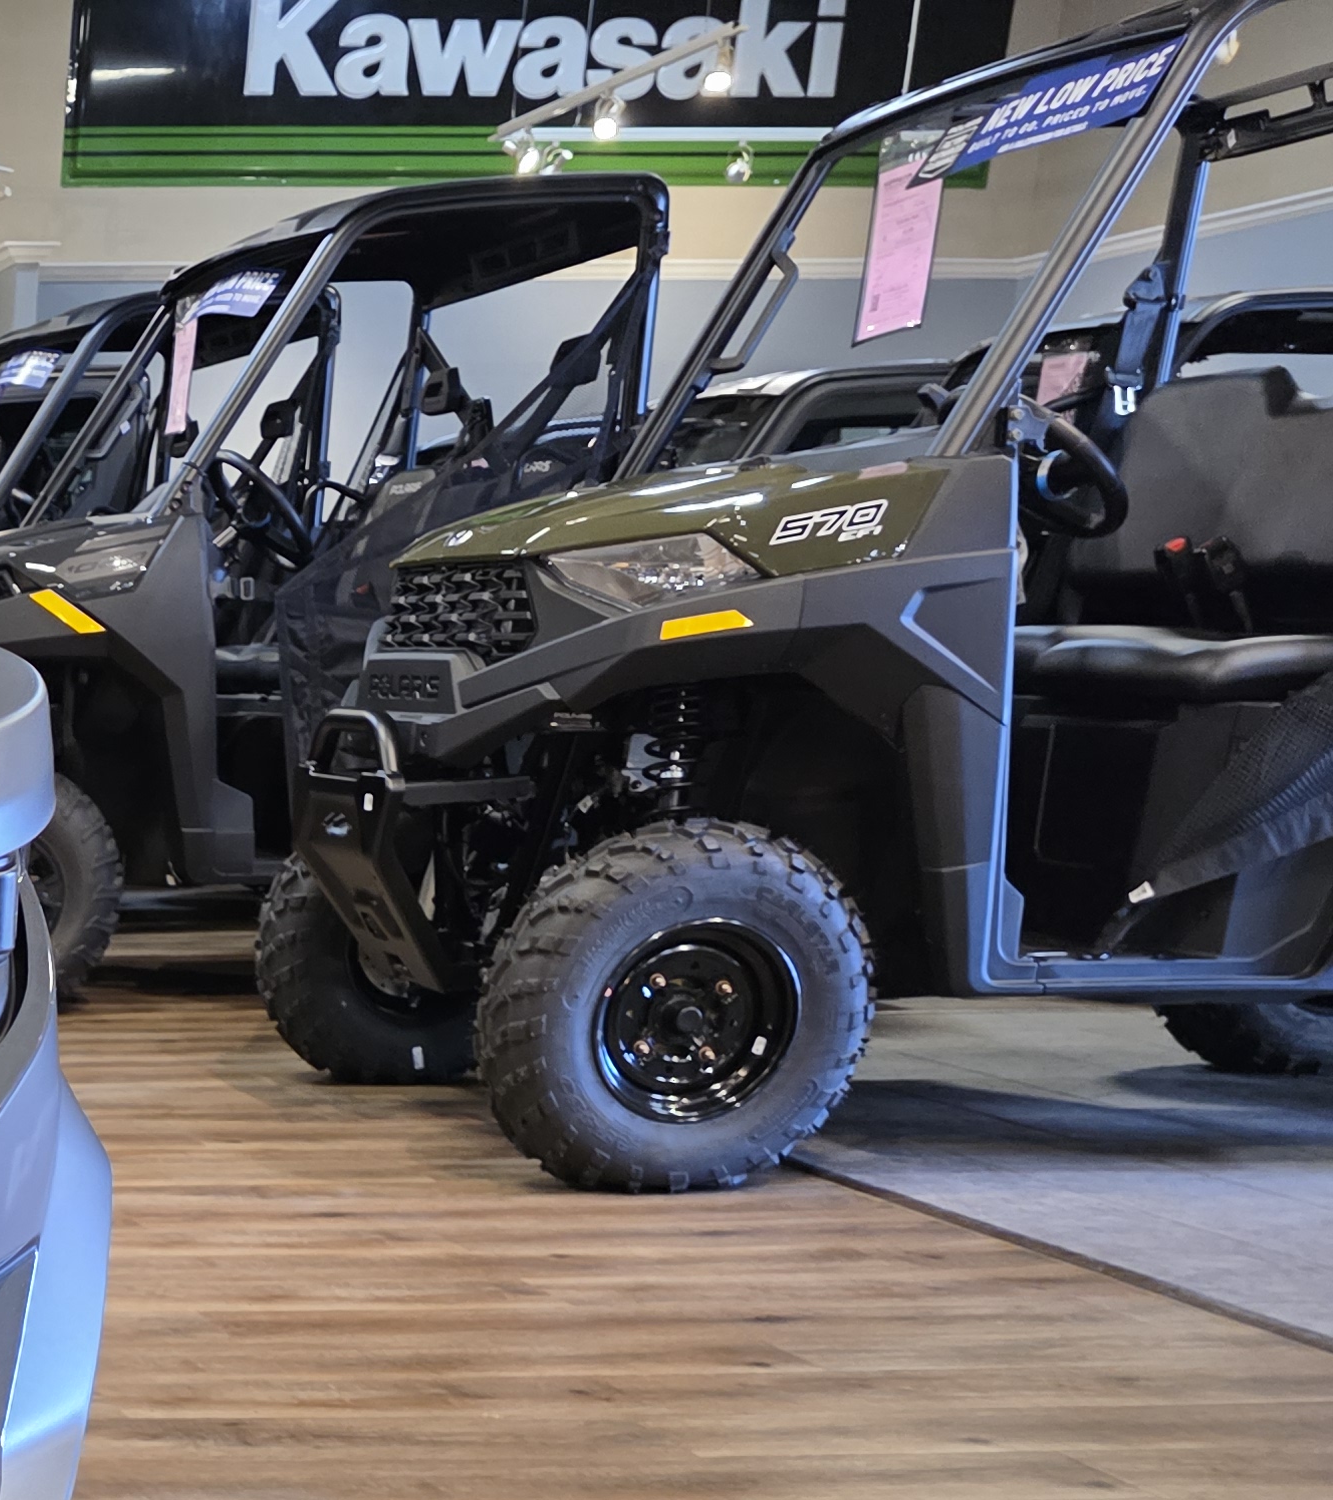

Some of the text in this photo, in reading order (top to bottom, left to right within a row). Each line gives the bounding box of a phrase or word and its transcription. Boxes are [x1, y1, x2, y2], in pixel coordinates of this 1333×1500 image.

[244, 0, 846, 99] Kawasaki
[981, 44, 1177, 135] NEW LOW PRICE
[1092, 98, 1110, 113] TO
[768, 498, 889, 546] 570
[837, 524, 883, 542] EFI
[369, 674, 441, 702] POLARIS
